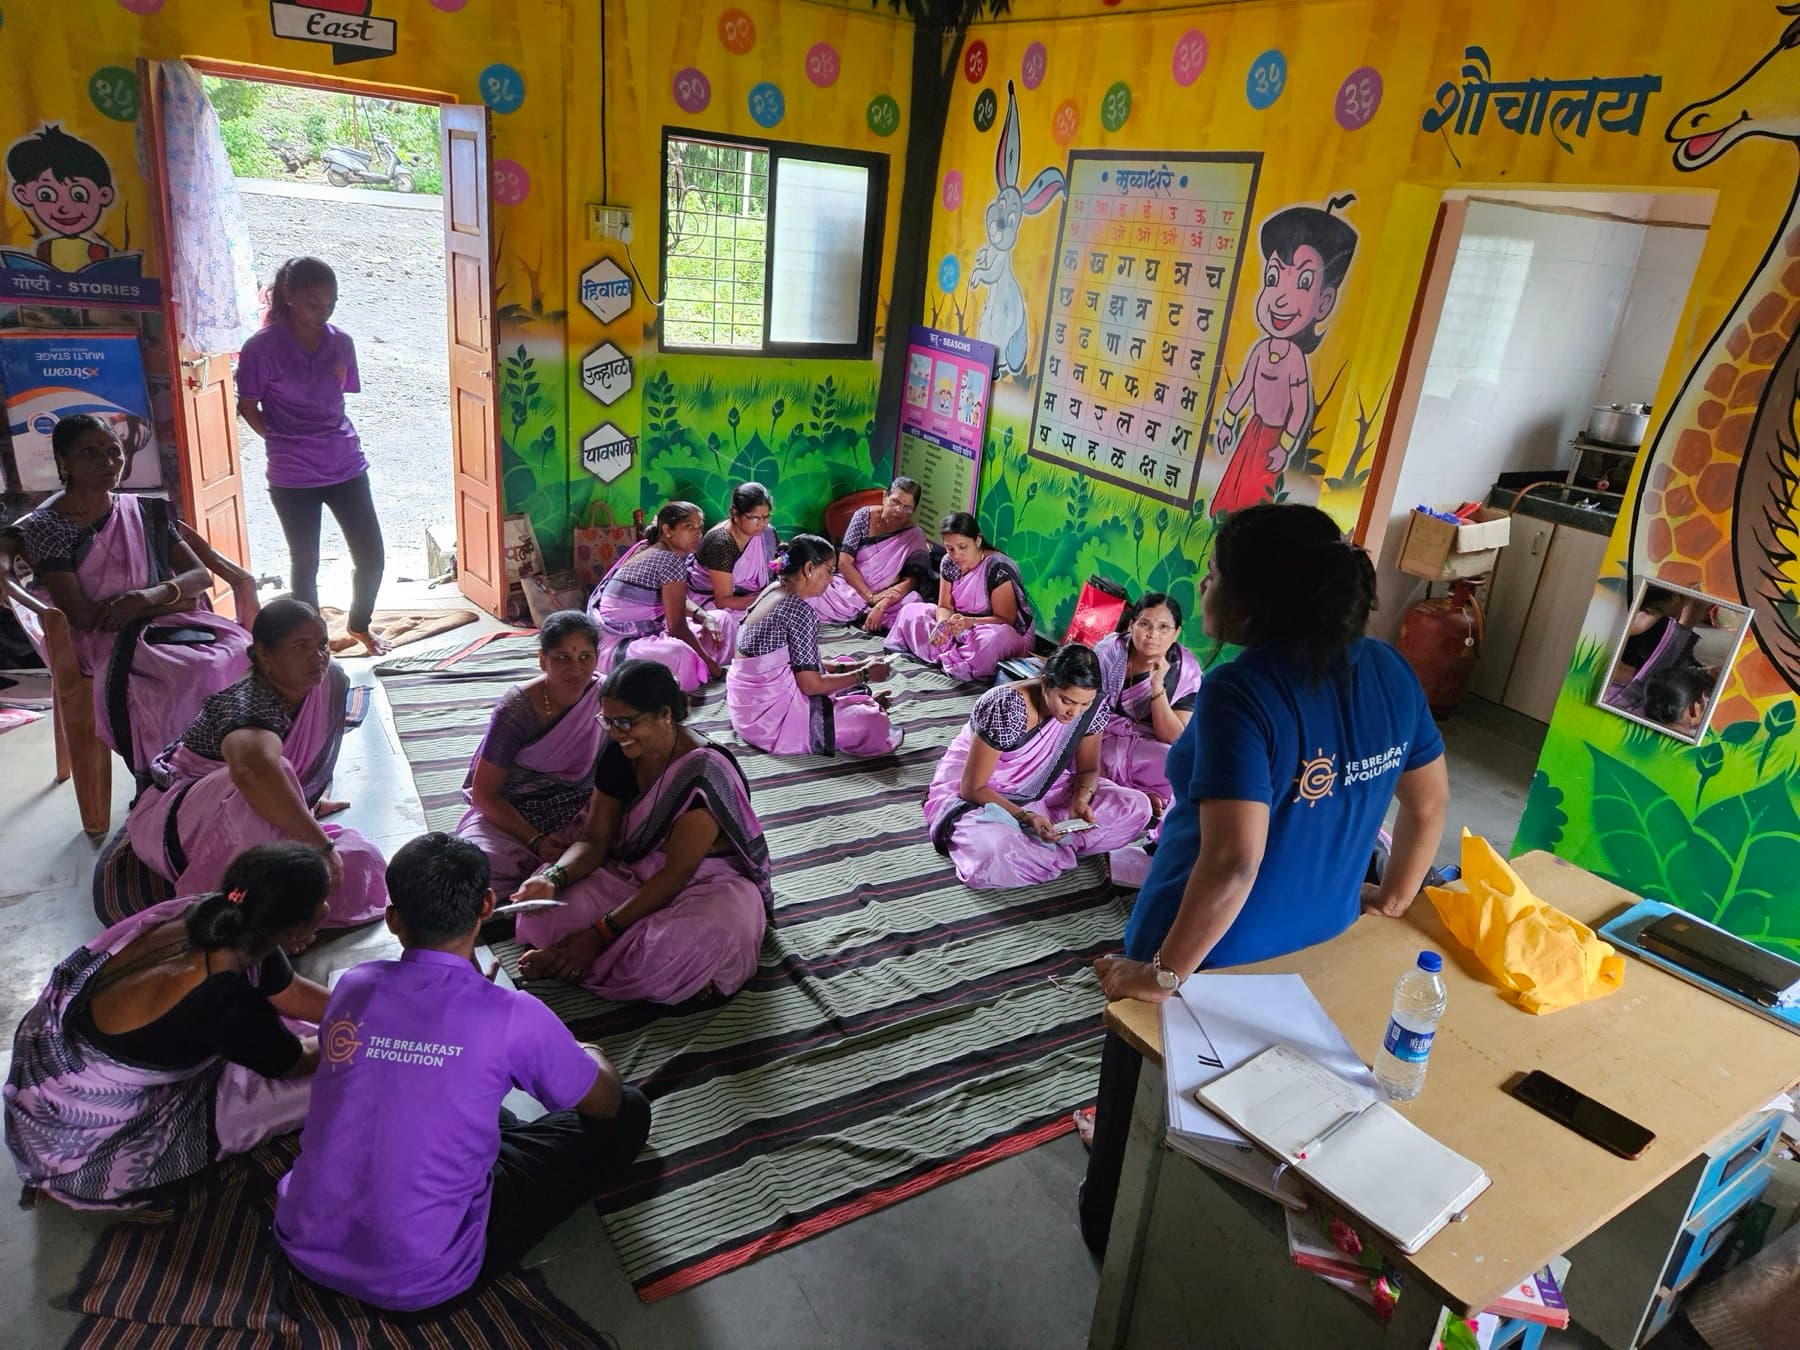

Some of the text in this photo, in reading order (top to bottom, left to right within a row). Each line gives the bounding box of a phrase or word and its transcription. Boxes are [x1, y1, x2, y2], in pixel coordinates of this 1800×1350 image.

[307, 13, 374, 41] East
[969, 51, 985, 76] २६
[1255, 63, 1282, 96] ३५
[679, 78, 705, 104] २०
[1345, 77, 1375, 121] ३६
[1422, 46, 1662, 168] शौचालय
[977, 98, 994, 126] २७
[1106, 91, 1128, 129] ३३
[1115, 164, 1175, 199] मुळाक्षरे
[1168, 206, 1178, 220] उ
[1194, 208, 1206, 224] ऊ
[1222, 210, 1235, 225] ए
[1216, 236, 1235, 250] अः
[12, 274, 50, 292] गोष्टी
[68, 281, 141, 296] STORIES
[1064, 250, 1079, 271] क
[1090, 251, 1108, 275] ख
[1117, 255, 1136, 278] ग
[1145, 258, 1160, 282] घ
[1205, 265, 1225, 290] च
[583, 278, 632, 313] हिवाळा
[1060, 287, 1073, 307] छ
[1086, 291, 1100, 312] ज
[1109, 294, 1128, 322] झ
[1168, 302, 1183, 326] ट
[1196, 307, 1213, 333] ठ
[36, 352, 105, 361] MULTI STAGE
[943, 337, 971, 352] SEASONS
[1055, 323, 1205, 379] ड ढ ण त थ द
[43, 367, 100, 379] xStream
[583, 356, 632, 389] उन्हाळा
[1049, 355, 1198, 413] ध न प फ ब भ
[1044, 391, 1192, 456] म य र ल व श
[1039, 424, 1052, 445] ष
[1087, 439, 1099, 468] ह
[1110, 446, 1126, 469] ळ
[1139, 454, 1158, 485] क्ष
[1164, 464, 1181, 492] ज्ञ
[366, 1048, 444, 1067] REVOLUTION
[370, 1036, 463, 1057] THE BREAKFAST
